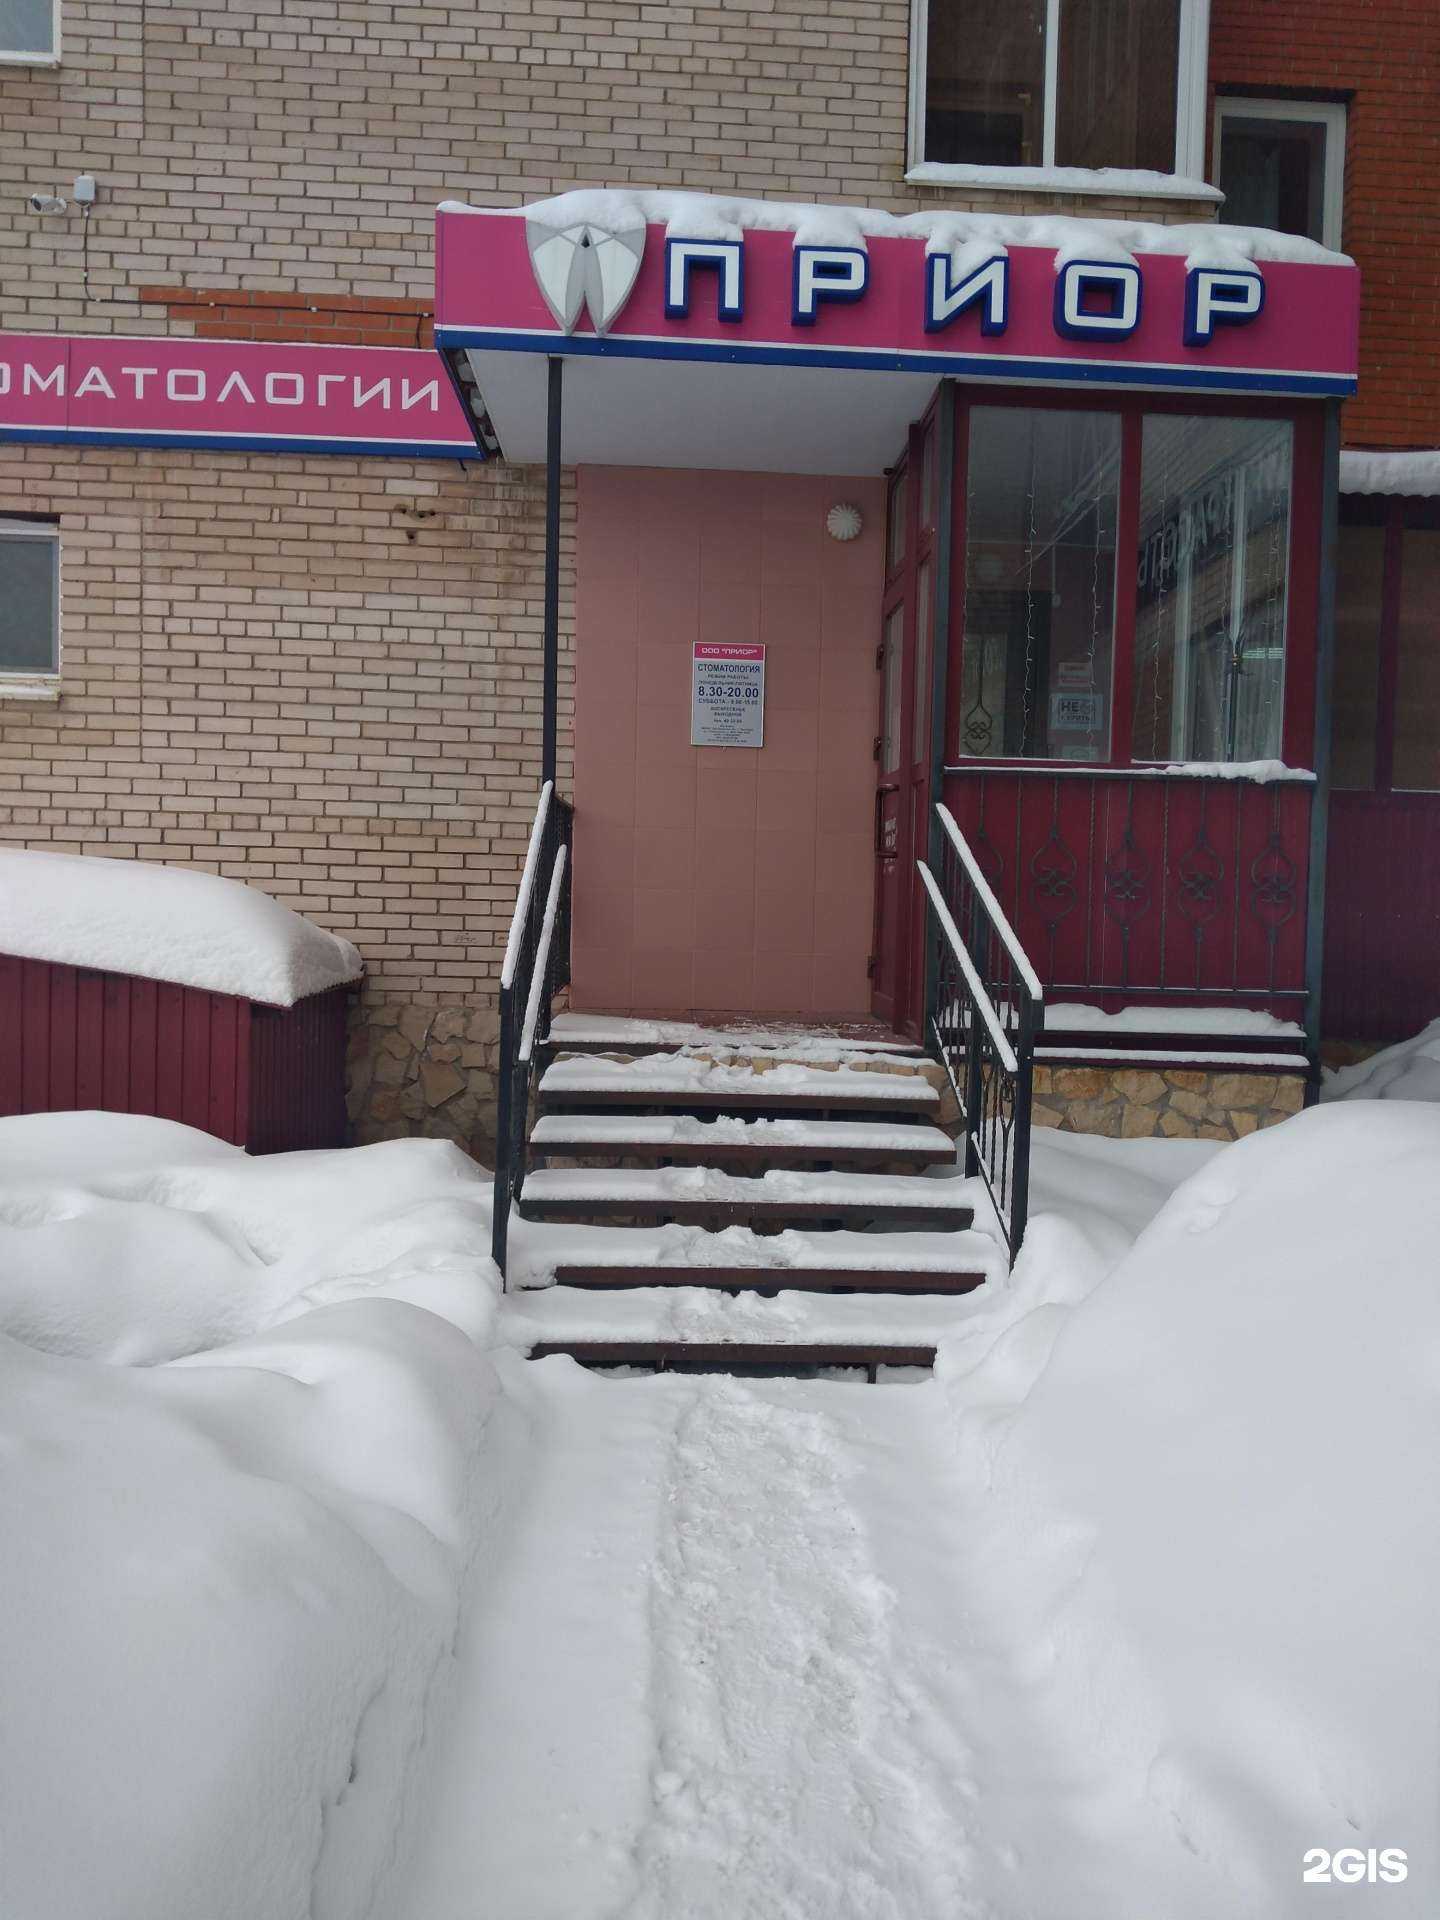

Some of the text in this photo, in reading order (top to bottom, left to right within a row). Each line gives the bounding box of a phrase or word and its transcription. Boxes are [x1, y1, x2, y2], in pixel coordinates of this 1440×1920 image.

[664, 237, 1265, 347] ПРИОР
[0, 362, 439, 411] МАТОЛОГИИ
[697, 663, 760, 673] СТОМАТОЛОГИЯ
[698, 685, 759, 698] 8.30-20.00
